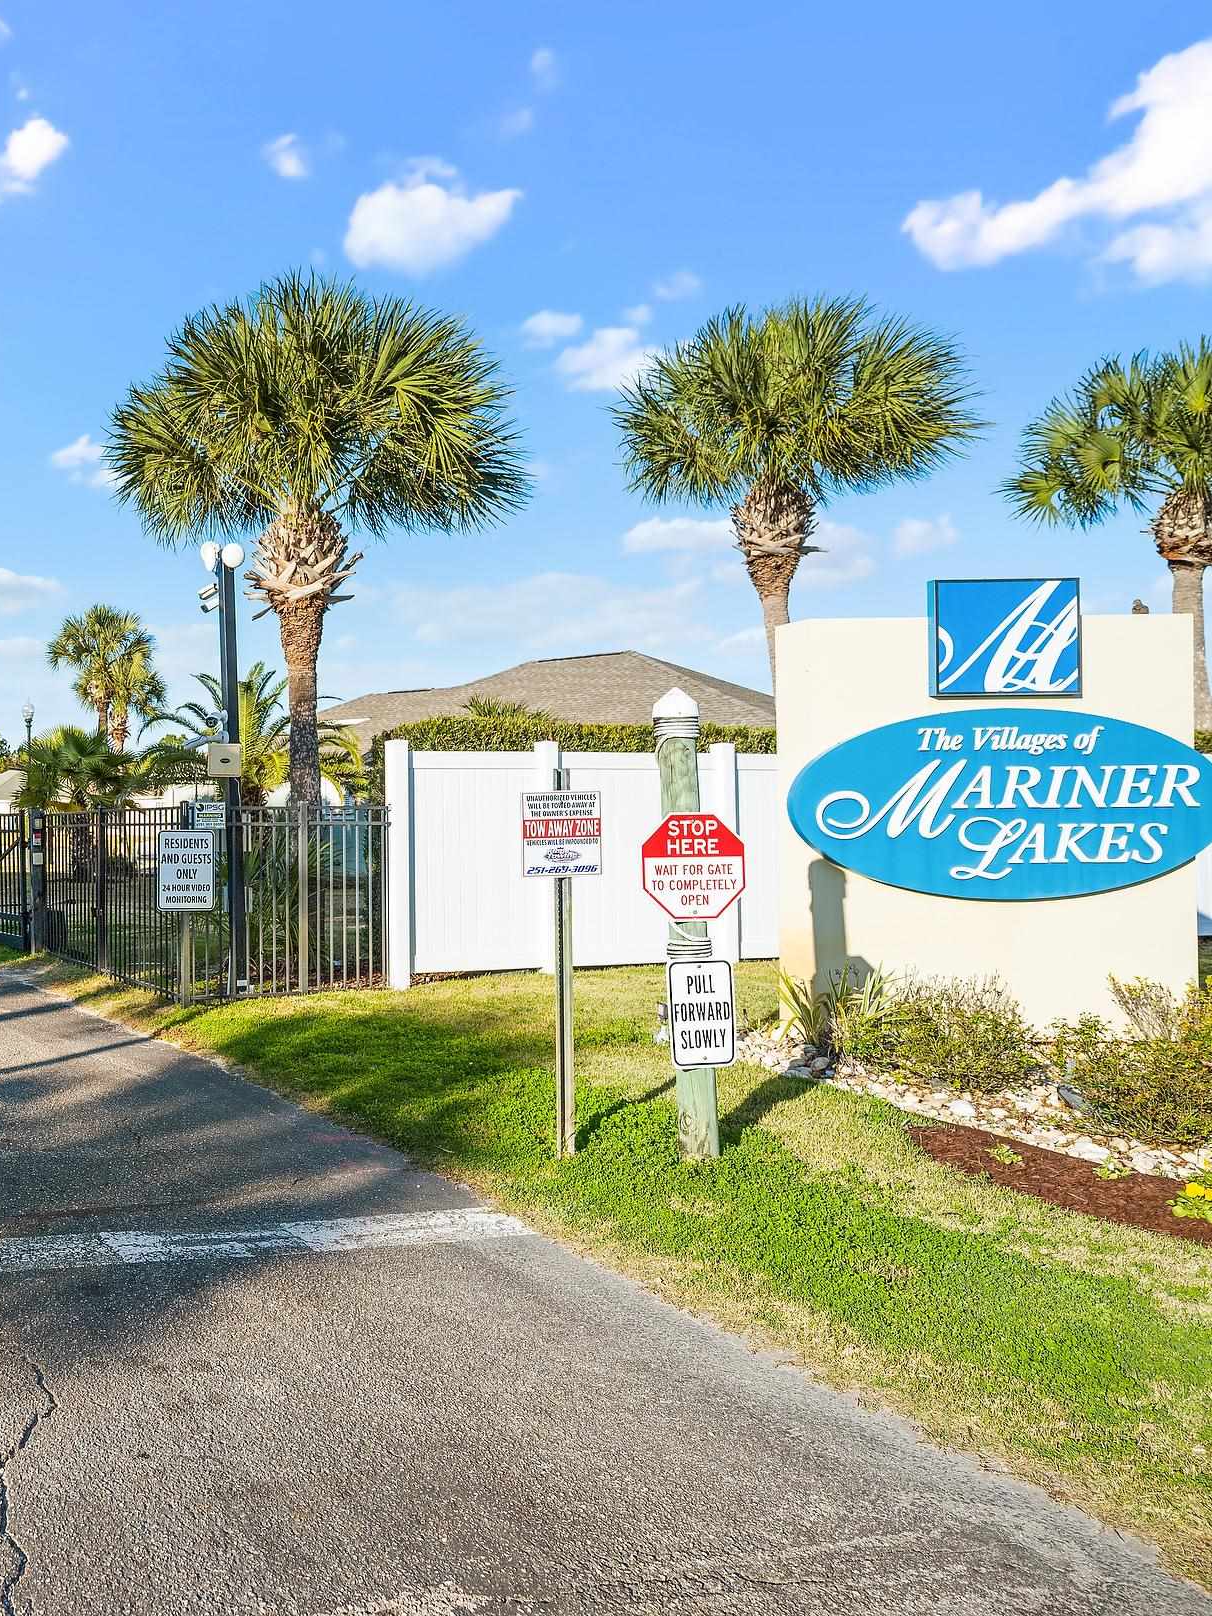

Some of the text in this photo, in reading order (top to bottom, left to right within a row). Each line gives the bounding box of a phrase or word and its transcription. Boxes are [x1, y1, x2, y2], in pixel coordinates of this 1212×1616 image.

[917, 725, 1106, 756] The Villages of
[526, 794, 570, 802] UNAUTHORIZED
[815, 759, 1201, 840] MARINER
[569, 809, 593, 817] EXPENSE
[525, 819, 600, 837] TOW AWAY ZONE
[667, 819, 718, 836] STOP
[164, 838, 209, 849] RESIDENTS
[565, 838, 592, 846] IMPOUNDED
[667, 838, 720, 855] HERE
[949, 816, 1169, 881] LAKES
[161, 853, 212, 864] AND GUESTS
[176, 868, 198, 880] ONLY
[527, 864, 599, 874] 251-269-3096
[654, 863, 733, 876] WAIT FOR GATE
[162, 884, 211, 892] 24 HOUR VIDEO
[652, 879, 737, 891] TO COMPLETELY
[165, 895, 207, 903] MONITORING
[681, 894, 709, 906] OPEN
[686, 974, 716, 995] PULL
[674, 1001, 730, 1022] FORWARD
[680, 1028, 726, 1049] SLOWLY
